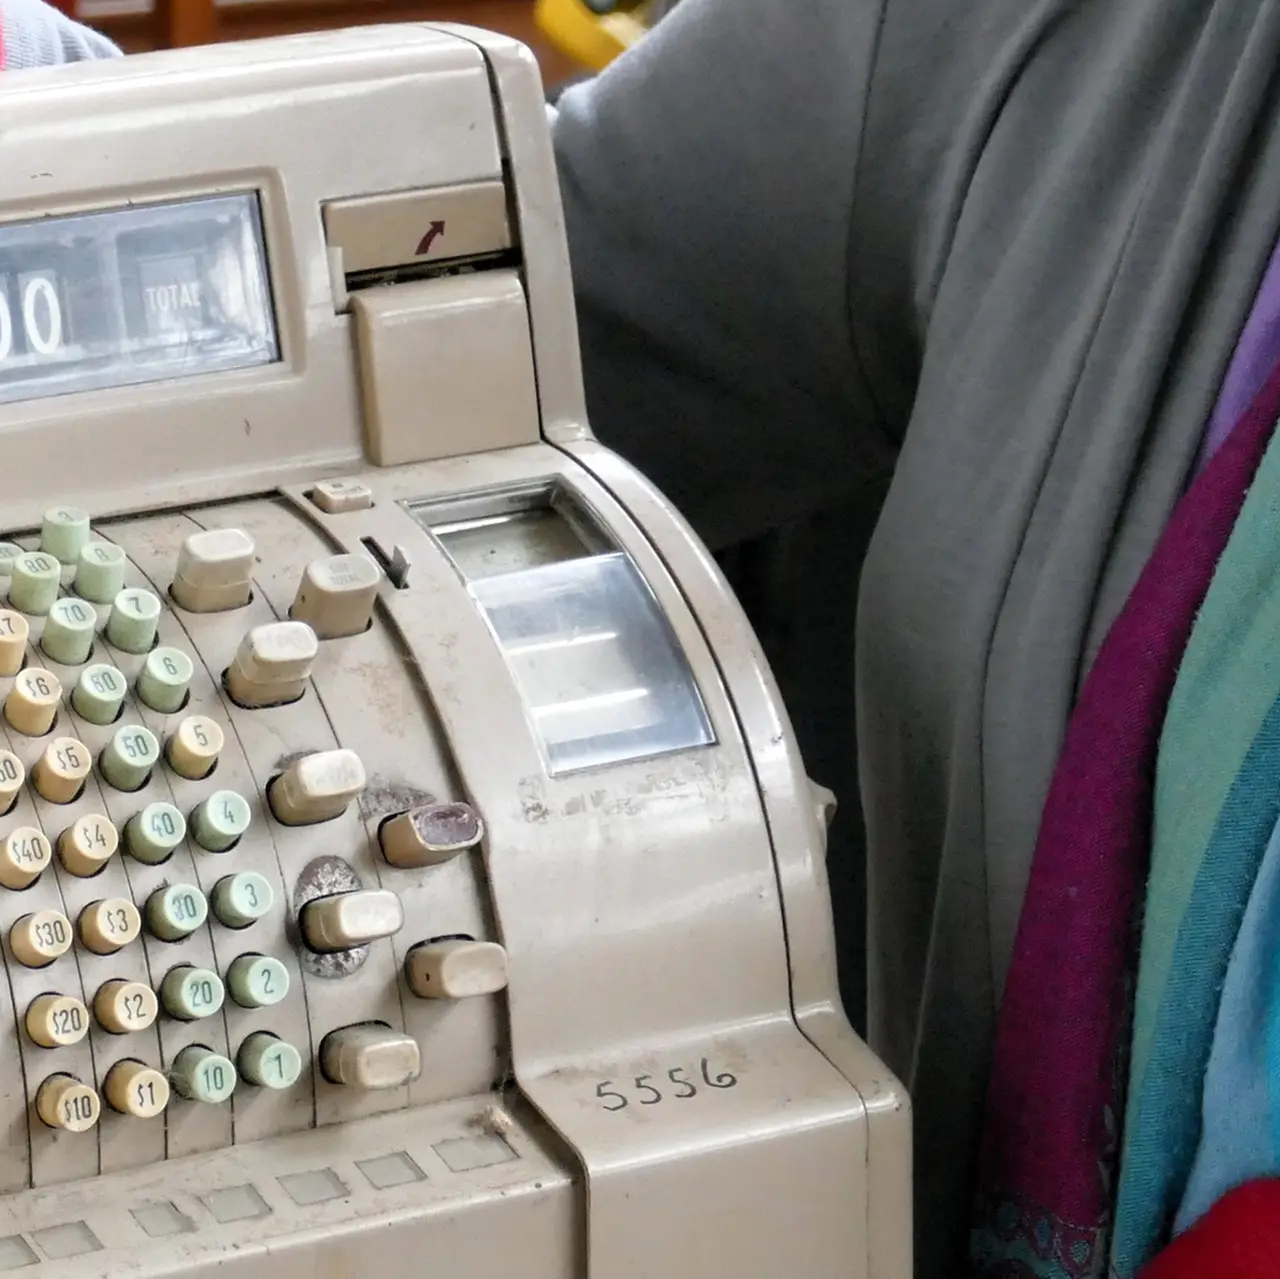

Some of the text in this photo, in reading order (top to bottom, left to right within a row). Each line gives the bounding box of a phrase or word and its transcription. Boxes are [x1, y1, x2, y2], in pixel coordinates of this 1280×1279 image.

[145, 282, 201, 312] TOTAL
[24, 556, 51, 573] 80
[58, 604, 87, 623] 70
[125, 596, 141, 613] 7
[162, 656, 178, 675] 6
[26, 676, 51, 697] $6
[121, 734, 149, 758] 50
[193, 724, 208, 747] 5
[56, 746, 81, 771] $5
[222, 800, 235, 824] 4
[83, 824, 106, 849] $4
[151, 812, 176, 838] 40
[12, 837, 44, 864] $40
[244, 883, 258, 907] 3
[106, 908, 129, 933] $3
[35, 920, 66, 947] $30
[190, 980, 213, 1007] 20
[261, 968, 275, 994] 2
[124, 993, 146, 1020] $2
[52, 1007, 82, 1035] $20
[202, 1065, 224, 1092] 10
[274, 1054, 285, 1079] 1
[137, 1081, 155, 1108] $1
[596, 1057, 738, 1111] 5556
[64, 1095, 93, 1122] $10
